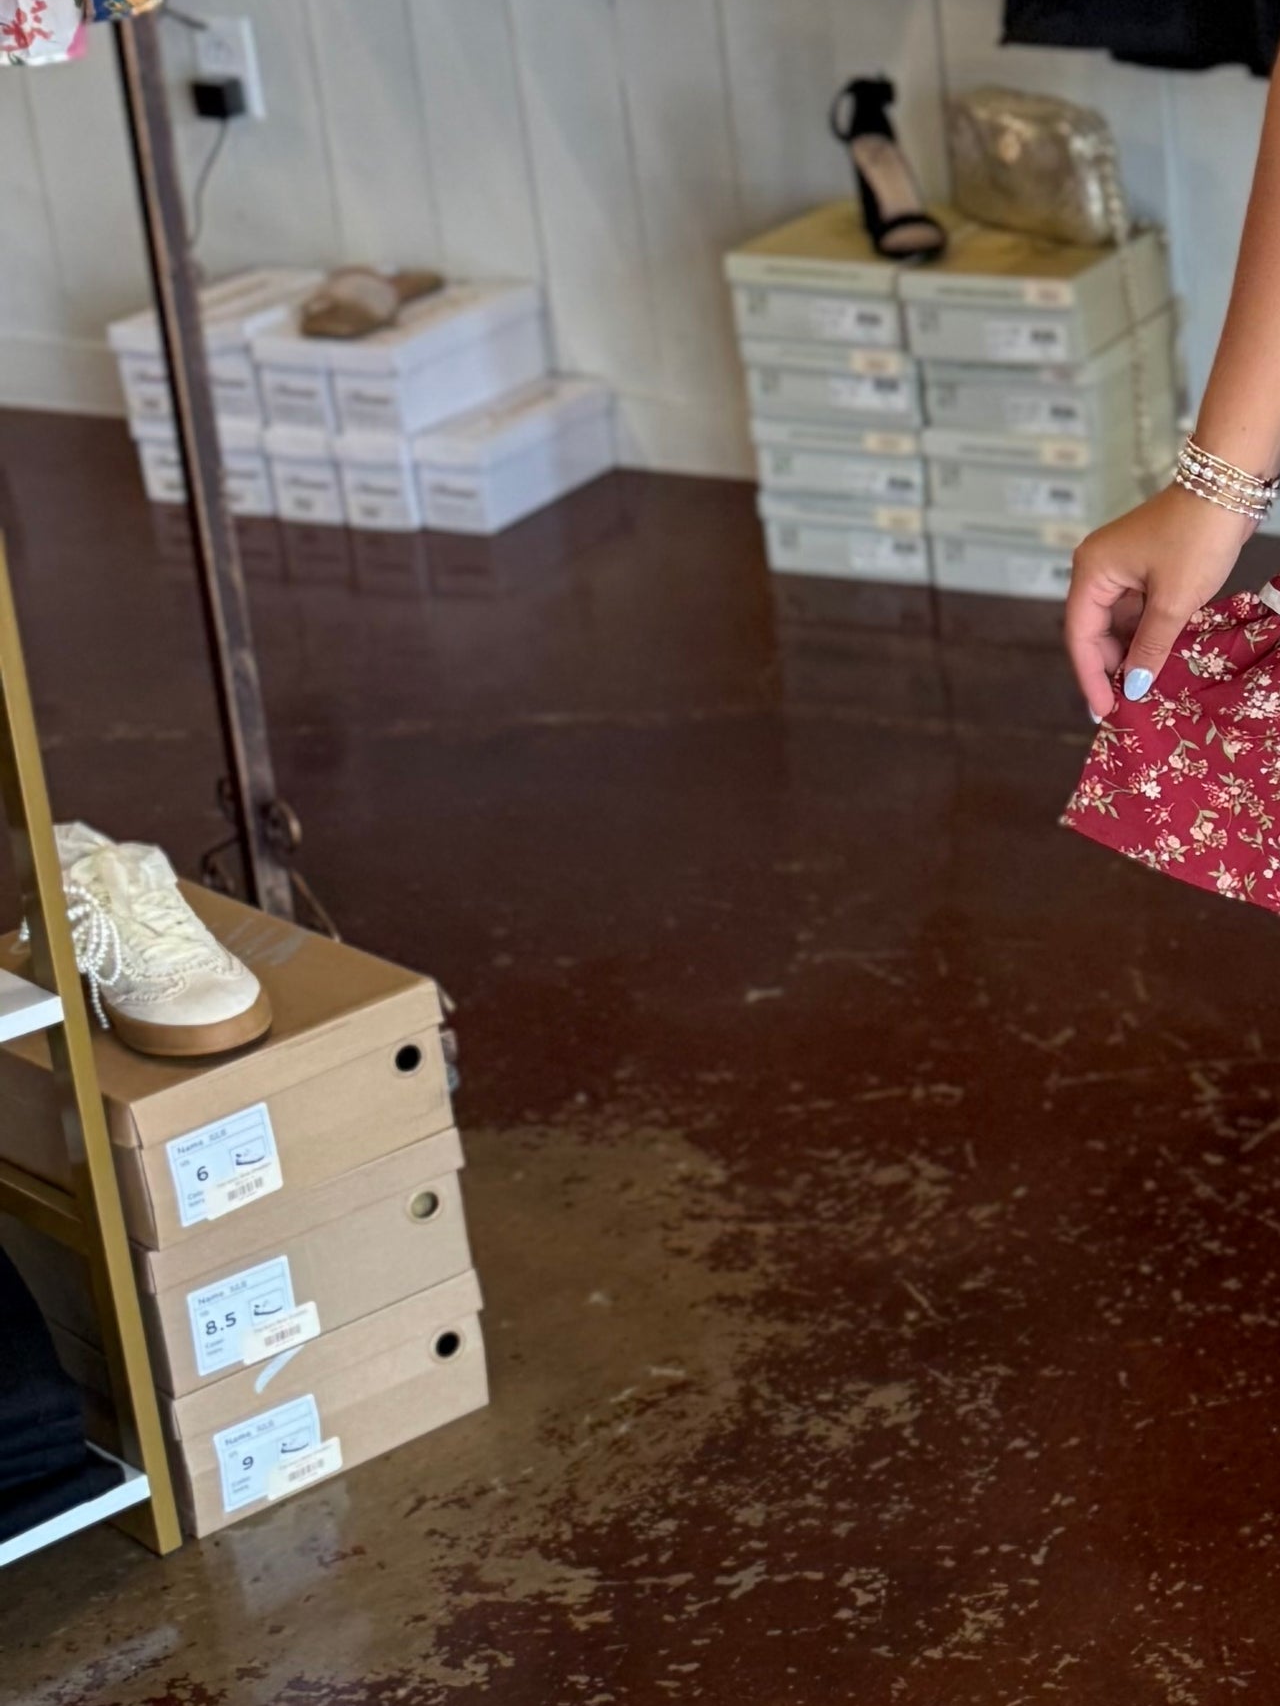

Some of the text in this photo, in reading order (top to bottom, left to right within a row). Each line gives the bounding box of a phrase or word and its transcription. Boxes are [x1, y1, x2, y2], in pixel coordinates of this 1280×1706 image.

[196, 1165, 209, 1182] 6
[205, 1311, 237, 1336] 8.5
[241, 1455, 254, 1471] 9
